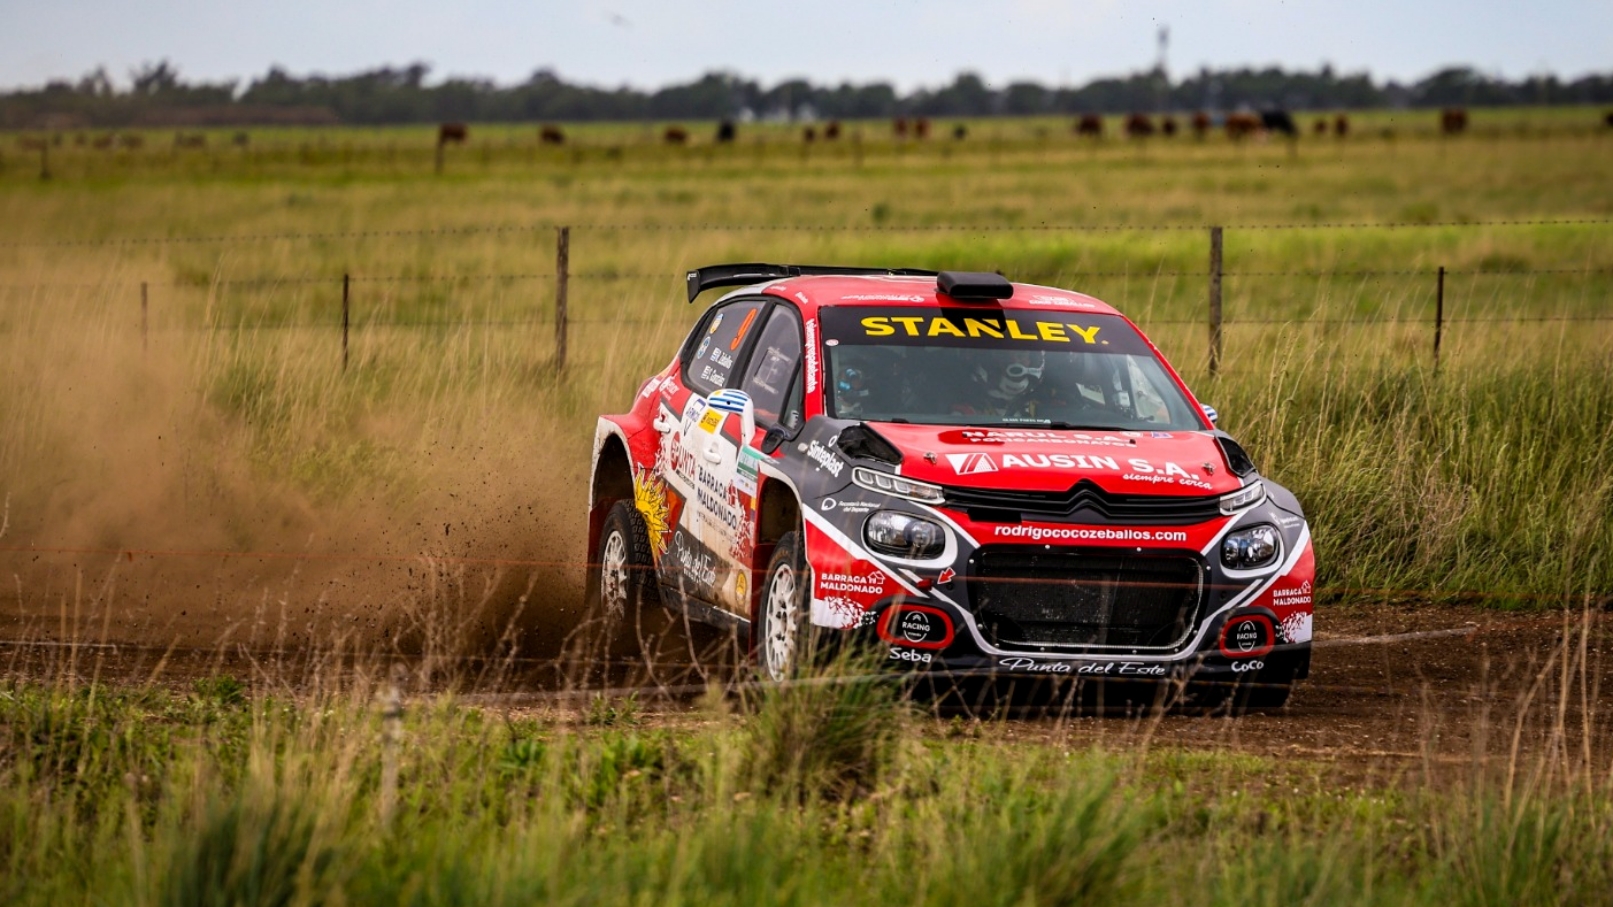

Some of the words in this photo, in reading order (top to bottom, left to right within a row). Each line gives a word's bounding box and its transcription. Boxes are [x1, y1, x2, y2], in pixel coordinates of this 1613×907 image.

[730, 308, 757, 352] 9
[861, 316, 1101, 344] STANLEY
[970, 437, 1138, 448] POLICARBONATOS
[807, 440, 845, 478] Sinteplast
[1002, 454, 1120, 471] AUSIN
[1128, 458, 1200, 480] S.A.
[698, 464, 727, 502] BARRACA
[1123, 473, 1174, 485] siempre
[1179, 478, 1213, 490] cerca
[697, 487, 738, 531] MALDONADO
[994, 525, 1187, 542] rodrigococozeballos.com
[821, 573, 867, 584] BARRACA
[820, 582, 883, 594] MALDONADO
[1273, 588, 1302, 598] BARRACA
[1273, 596, 1312, 607] MALDONADO
[902, 621, 930, 632] RACING
[1237, 632, 1257, 640] RACING
[889, 647, 932, 663] Seba
[999, 658, 1071, 673] Punta
[1078, 662, 1114, 674] del
